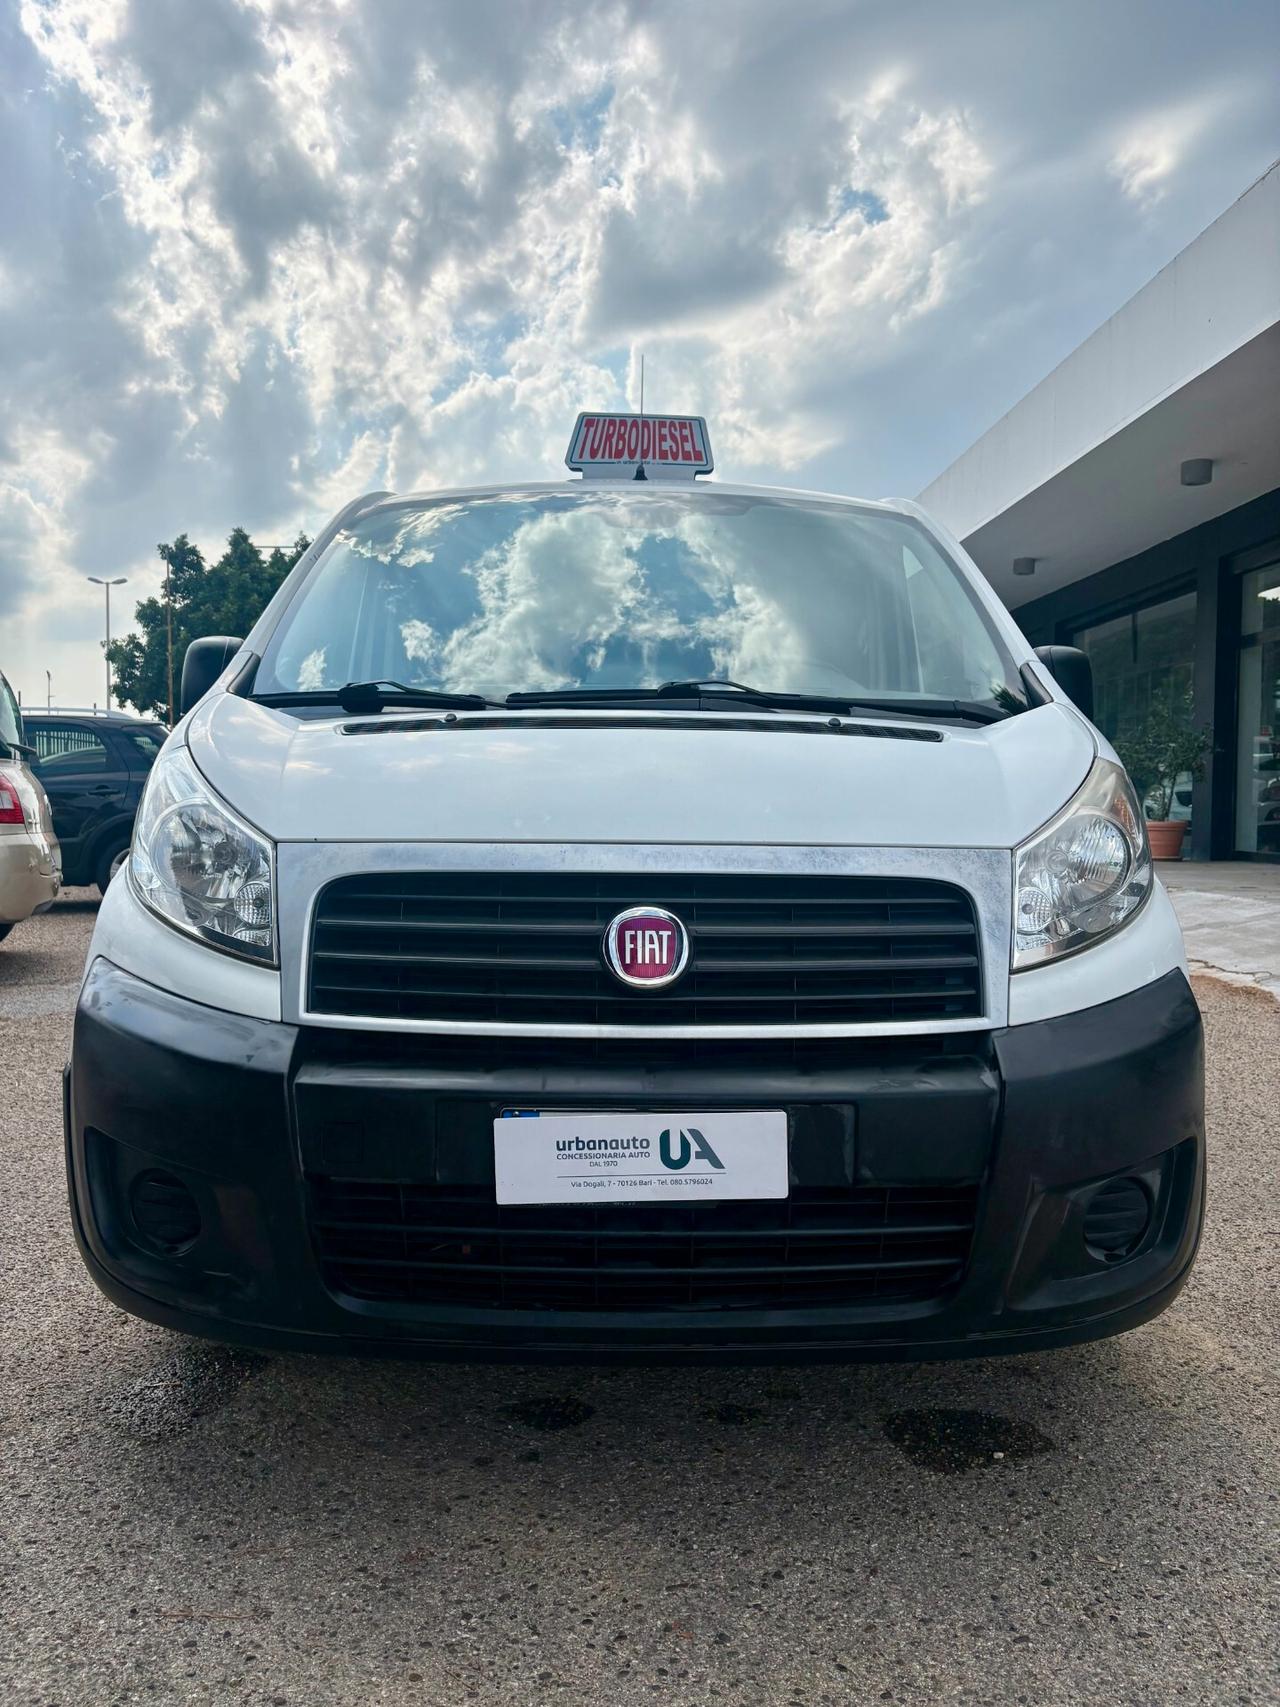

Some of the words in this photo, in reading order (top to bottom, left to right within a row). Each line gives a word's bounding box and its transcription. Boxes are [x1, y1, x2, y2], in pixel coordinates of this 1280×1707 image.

[578, 418, 704, 461] TURBODIESEL
[624, 930, 672, 965] FIAT
[556, 1136, 650, 1151] urbanauto
[556, 1152, 626, 1160] CONCESSIONARIA
[628, 1151, 650, 1159] AUTO
[659, 1128, 726, 1170] UA
[583, 1180, 606, 1189] Dogali,
